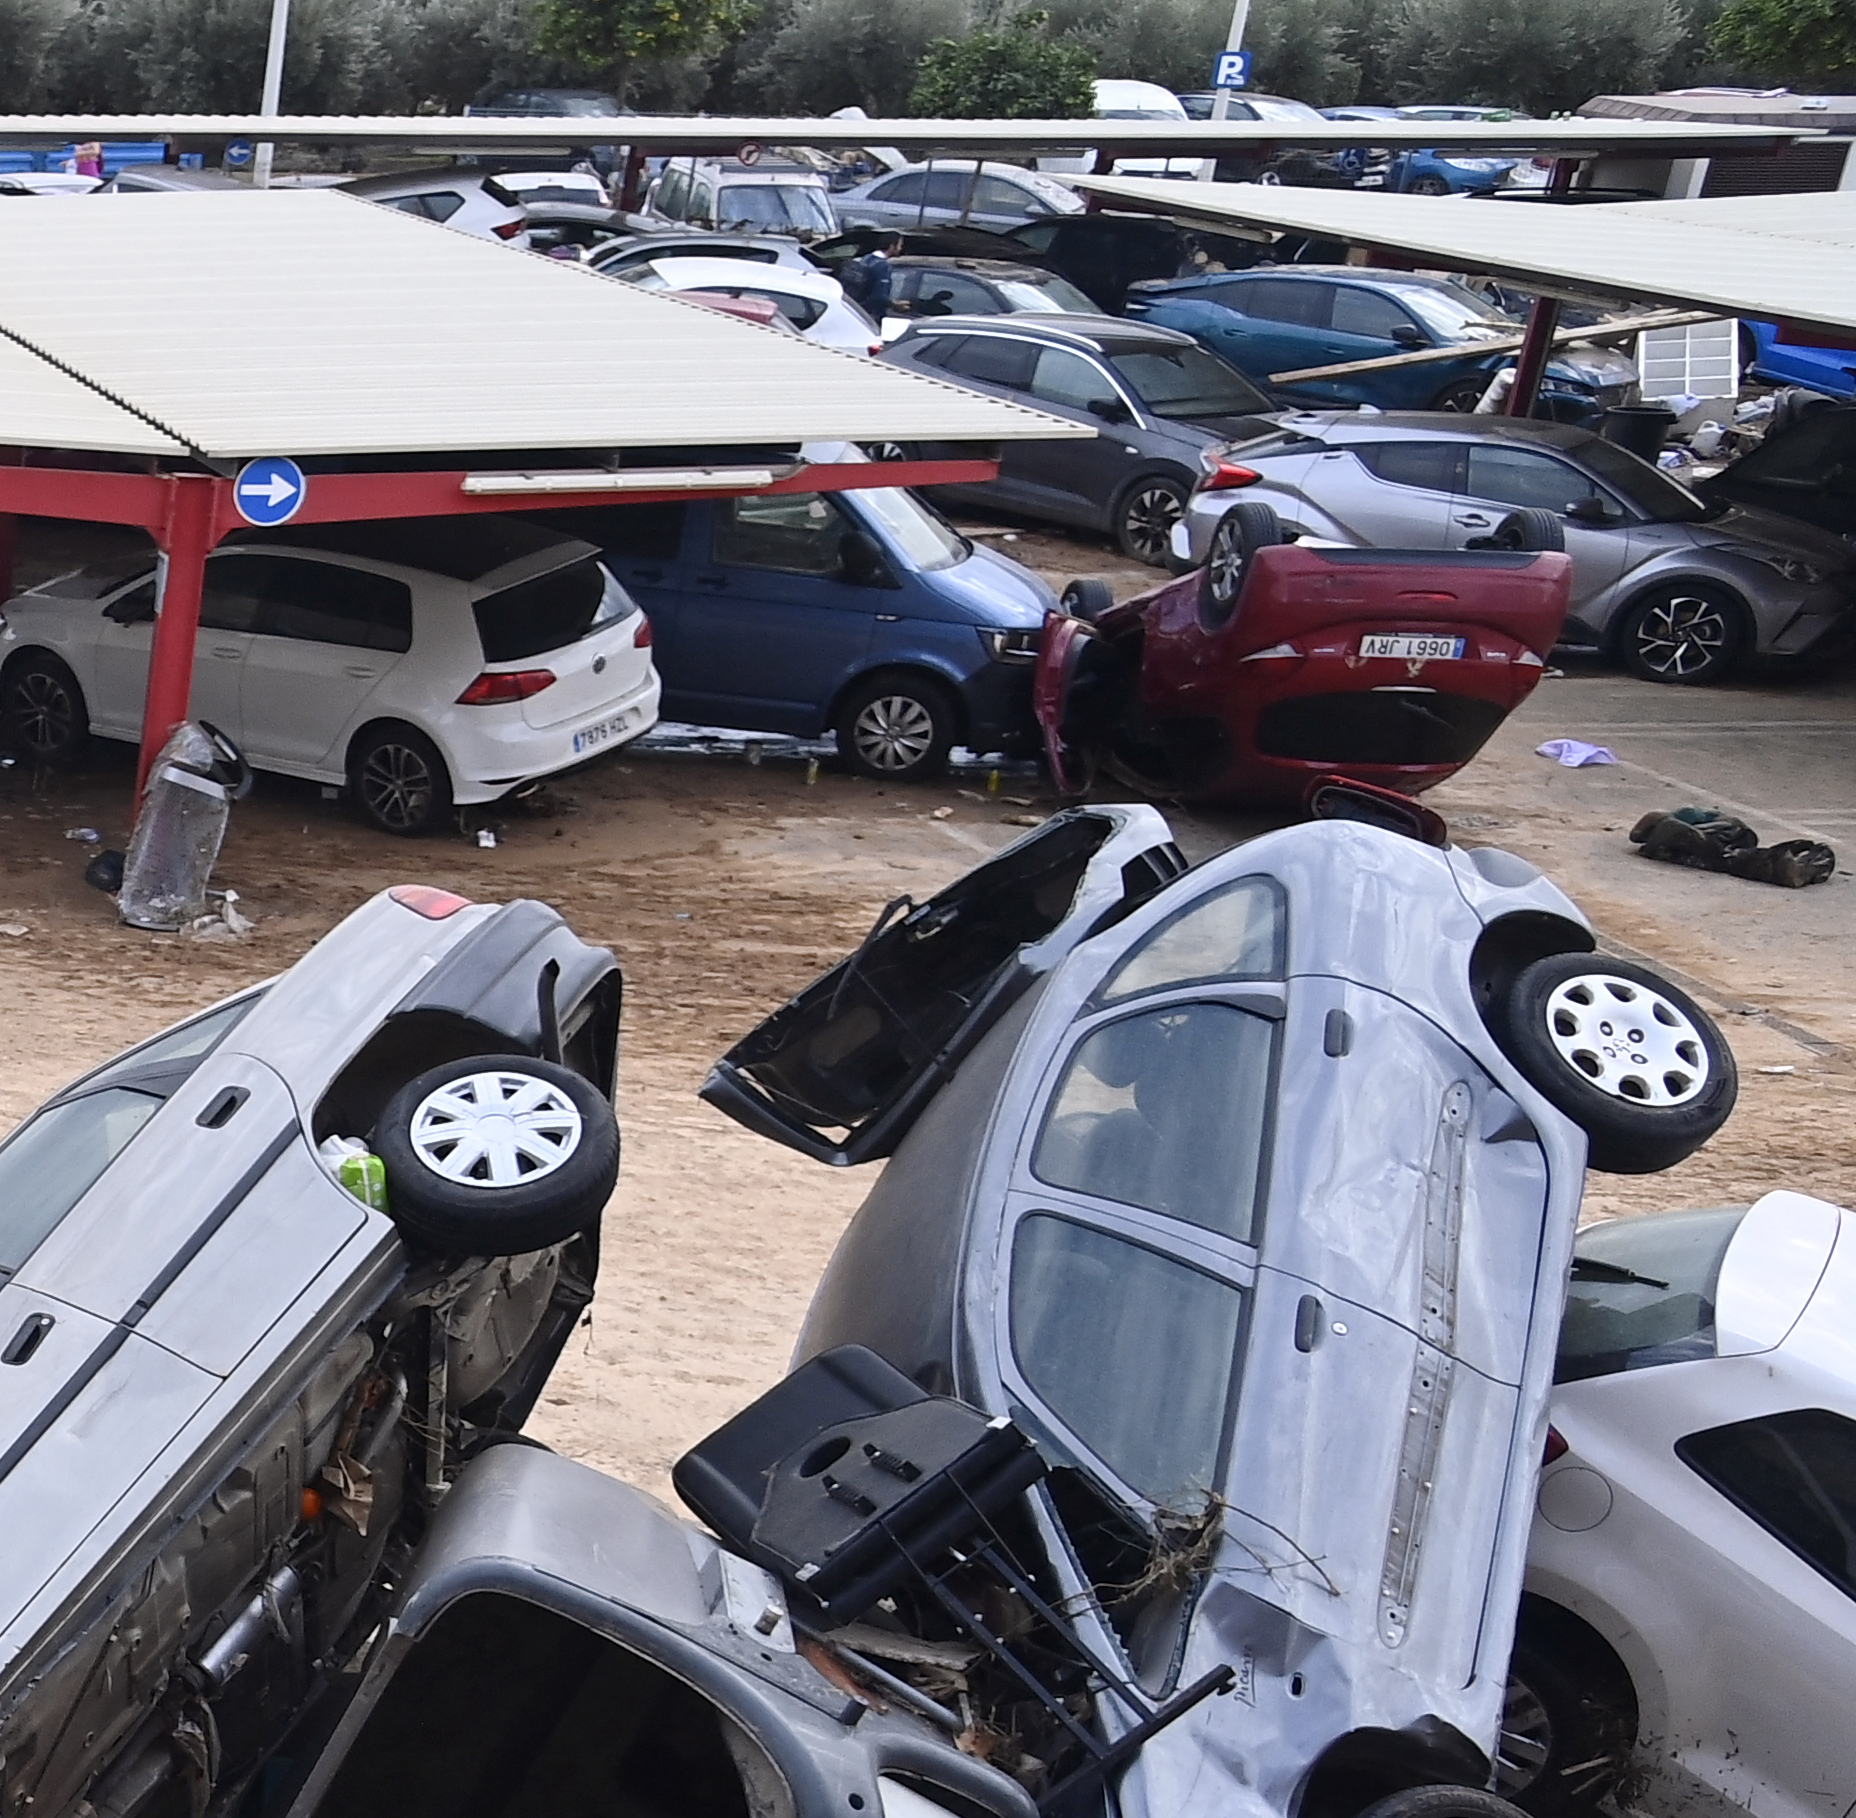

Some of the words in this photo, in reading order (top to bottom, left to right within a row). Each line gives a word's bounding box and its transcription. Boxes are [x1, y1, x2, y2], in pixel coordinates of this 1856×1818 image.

[1217, 56, 1243, 84] P
[1365, 638, 1401, 656] JRV
[1405, 640, 1450, 657] 0661
